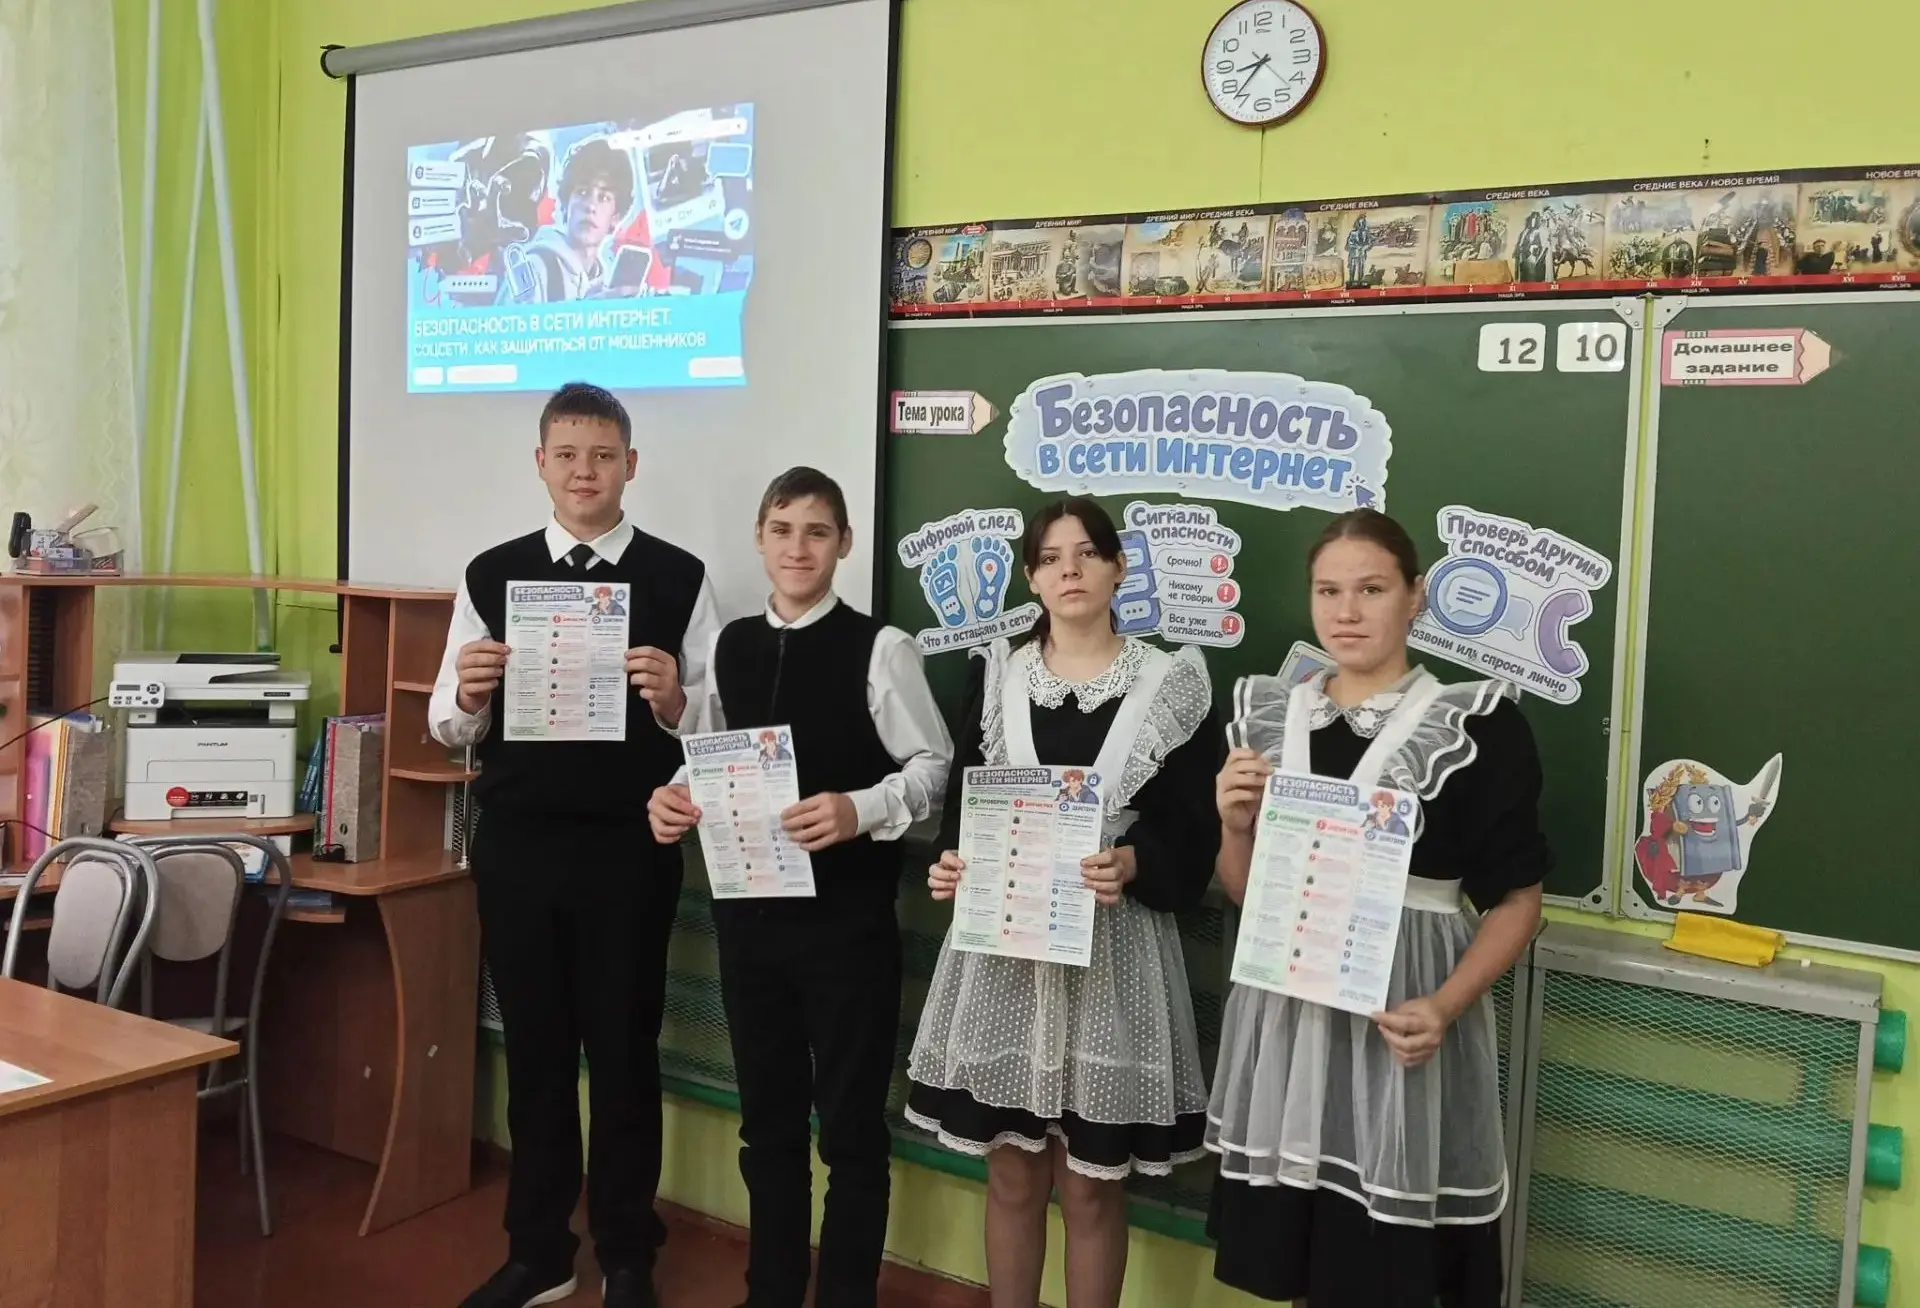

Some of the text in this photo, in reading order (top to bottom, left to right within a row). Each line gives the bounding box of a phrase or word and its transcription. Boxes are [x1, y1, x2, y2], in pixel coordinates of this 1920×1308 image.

[1253, 11, 1273, 27] 12
[1239, 20, 1248, 35] 11
[1290, 29, 1306, 44] 2
[1223, 38, 1240, 53] 10
[1293, 49, 1311, 64] 3
[1216, 60, 1234, 74] 9
[1288, 71, 1306, 85] 4
[1222, 79, 1238, 94] 8
[1236, 94, 1251, 108] 7
[1274, 87, 1291, 103] 5
[1254, 98, 1272, 112] 6
[1865, 170, 1901, 179] НОВОЕ
[1633, 182, 1677, 191] СРЕДНИЕ
[1679, 180, 1703, 189] ВЕКА
[1710, 178, 1744, 187] НОВОЕ
[1746, 175, 1780, 185] ВРЕМЯ
[1486, 189, 1550, 200] СРЕДНИЕ ВЕКА
[1320, 201, 1379, 211] СРЕДНИЕ ВЕКА
[1200, 210, 1234, 219] СРЕДНИЕ
[1236, 209, 1255, 217] ВЕКА
[414, 315, 527, 336] БЕЗОПАСНОСТЬ
[530, 314, 540, 331] В
[543, 311, 583, 331] СЕТИ
[475, 340, 497, 355] КАК
[501, 336, 586, 354] ЗАЩИТИТЬСЯ
[589, 336, 605, 351] ОТ
[608, 332, 706, 350] МОШЕННИКОВ
[1498, 337, 1538, 365] 12
[1576, 333, 1618, 362] 10
[1674, 341, 1793, 357] Домашнее
[1685, 361, 1779, 375] задание
[898, 401, 965, 426] Тема урока
[1036, 384, 1358, 450] Безопасность
[1039, 438, 1352, 493] в сети Интернет
[1131, 507, 1211, 527] Сигналы
[904, 515, 1016, 559] Цифровой след
[1151, 526, 1235, 549] опасности
[1447, 514, 1529, 547] Проверь
[1167, 556, 1202, 568] Срочно!
[1460, 539, 1556, 582] способом
[1168, 580, 1203, 594] Никому
[1168, 592, 1213, 604] не говори
[1169, 613, 1207, 627] Все уже
[923, 636, 940, 648] Что
[943, 635, 950, 645] я
[1000, 621, 1007, 631] в
[1168, 625, 1224, 638] согласились
[1407, 629, 1454, 650] озвони
[1481, 653, 1525, 677] спроси
[1527, 671, 1567, 693] лично
[972, 769, 1048, 778] БЕЗОПАСНОСТЬ
[1004, 776, 1049, 784] ИНТЕРНЕТ
[1276, 777, 1356, 795] БЕЗОПАСНОСТЬ
